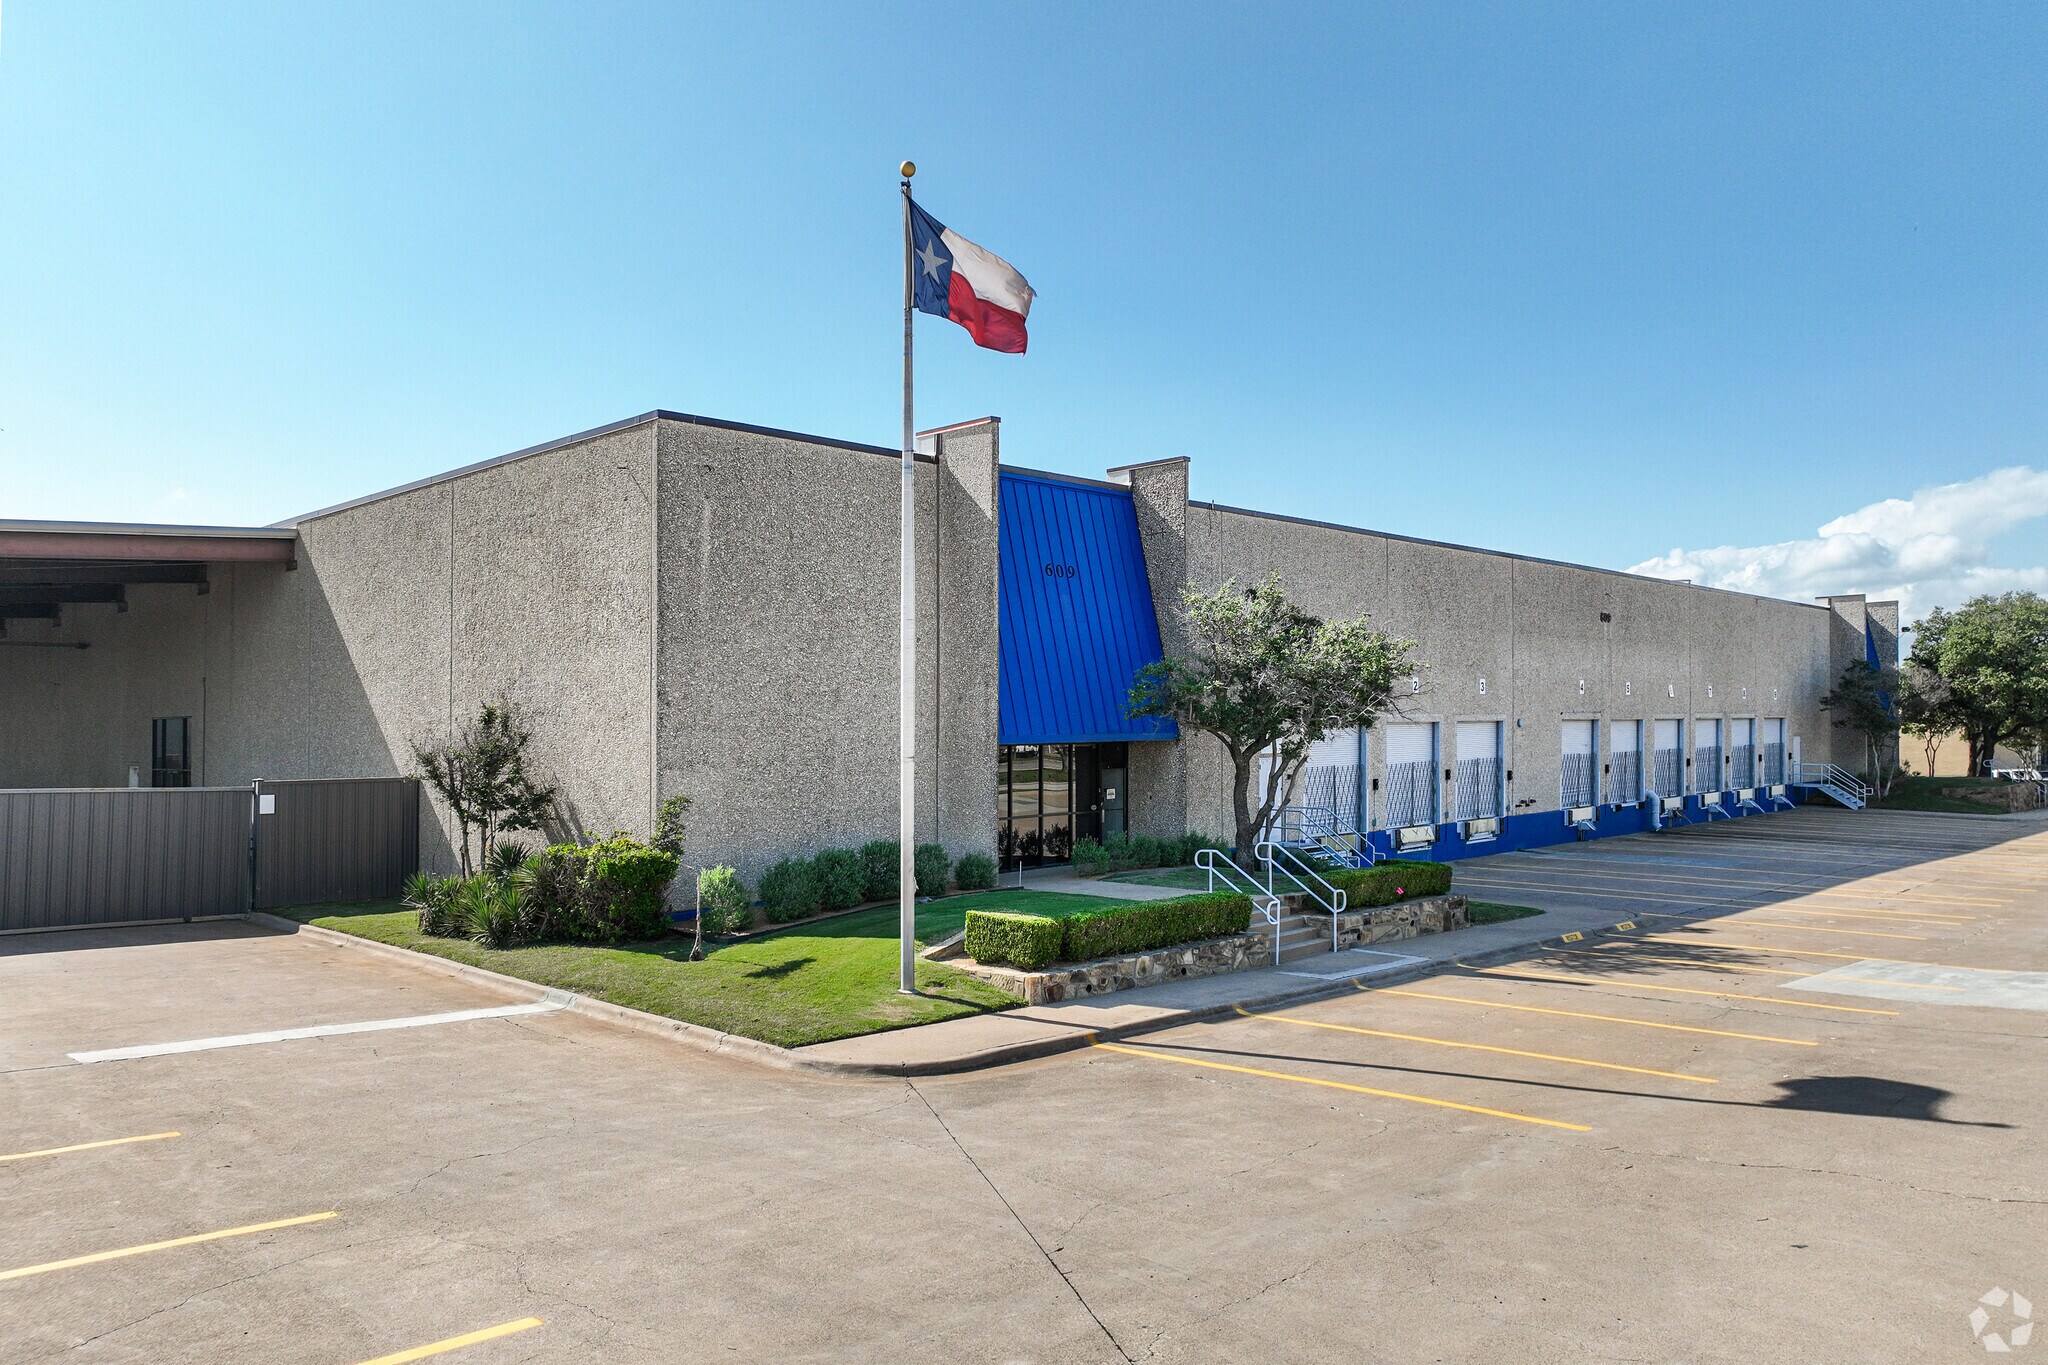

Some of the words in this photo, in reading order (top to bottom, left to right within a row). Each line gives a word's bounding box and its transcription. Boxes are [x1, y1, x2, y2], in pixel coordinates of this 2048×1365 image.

[1045, 563, 1075, 579] 609
[1413, 681, 1418, 691] 2
[1480, 682, 1485, 692] 3
